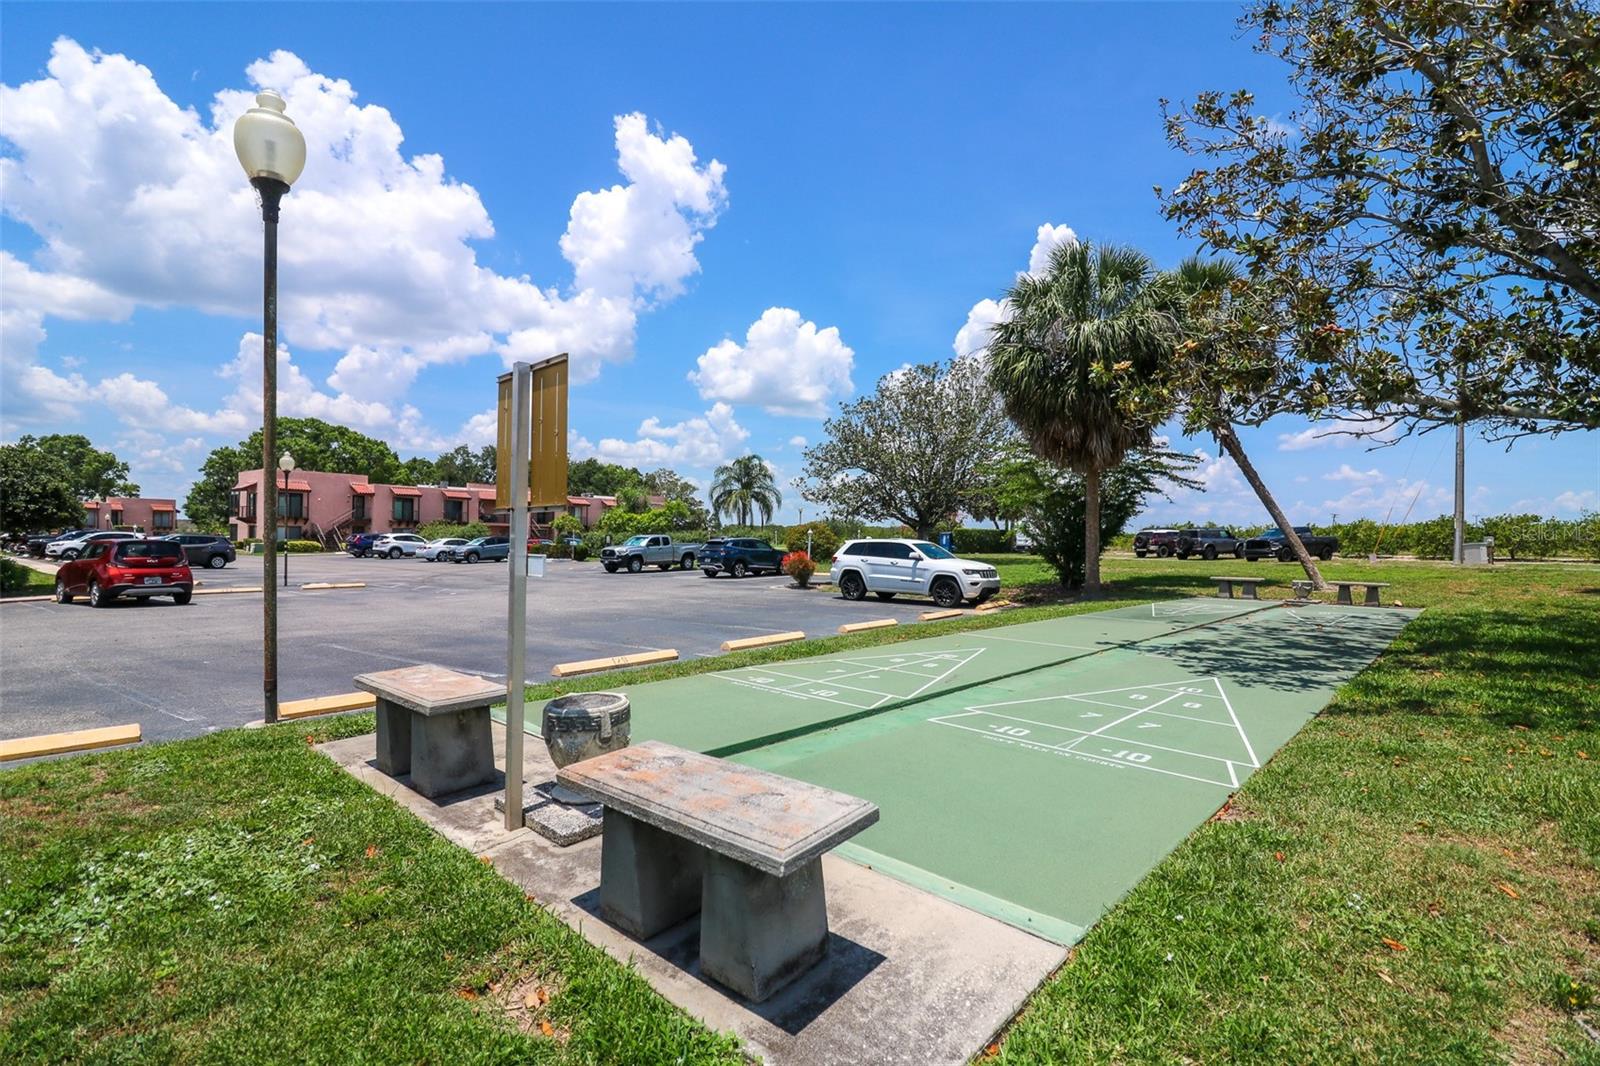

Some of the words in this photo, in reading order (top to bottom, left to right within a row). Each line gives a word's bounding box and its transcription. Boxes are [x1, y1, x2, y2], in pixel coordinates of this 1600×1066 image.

[808, 688, 839, 697] -10
[988, 724, 1031, 736] -10
[1101, 748, 1152, 763] -10
